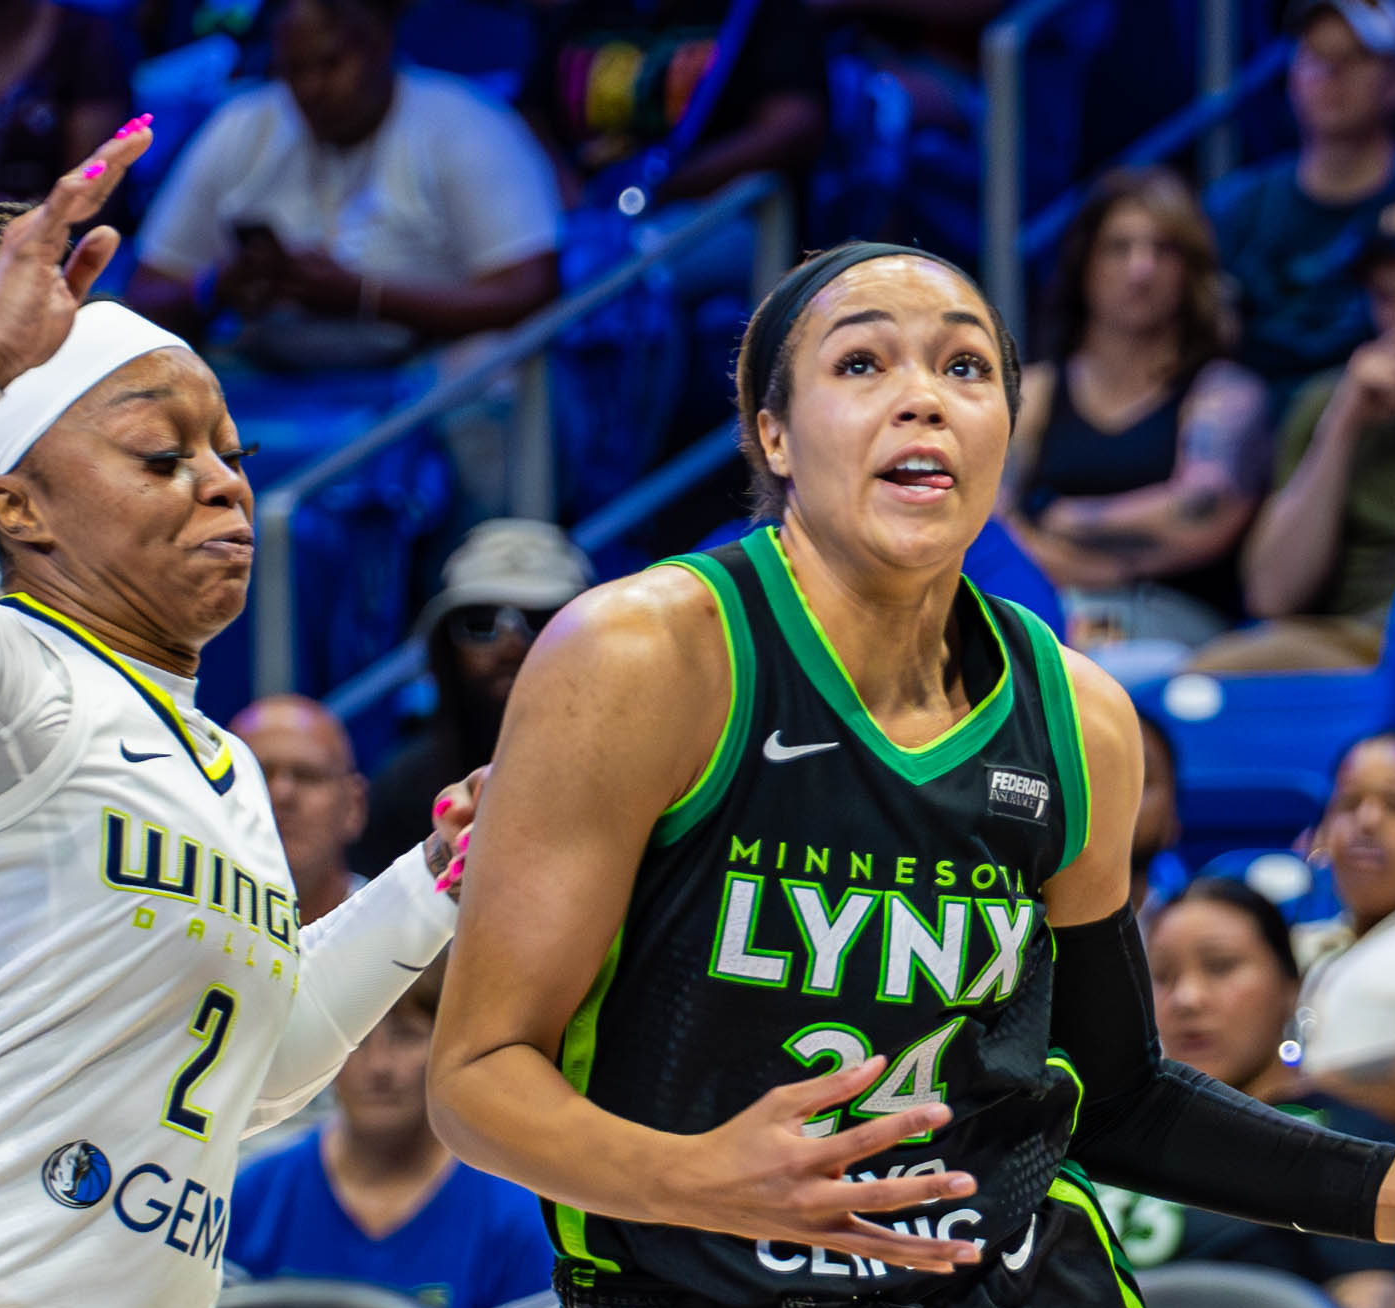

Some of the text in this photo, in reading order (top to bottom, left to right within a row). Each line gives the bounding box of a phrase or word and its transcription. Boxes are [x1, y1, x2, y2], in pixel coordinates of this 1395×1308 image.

[708, 870, 1034, 1007] LYNX
[160, 981, 240, 1142] 2
[781, 1015, 967, 1144] 24
